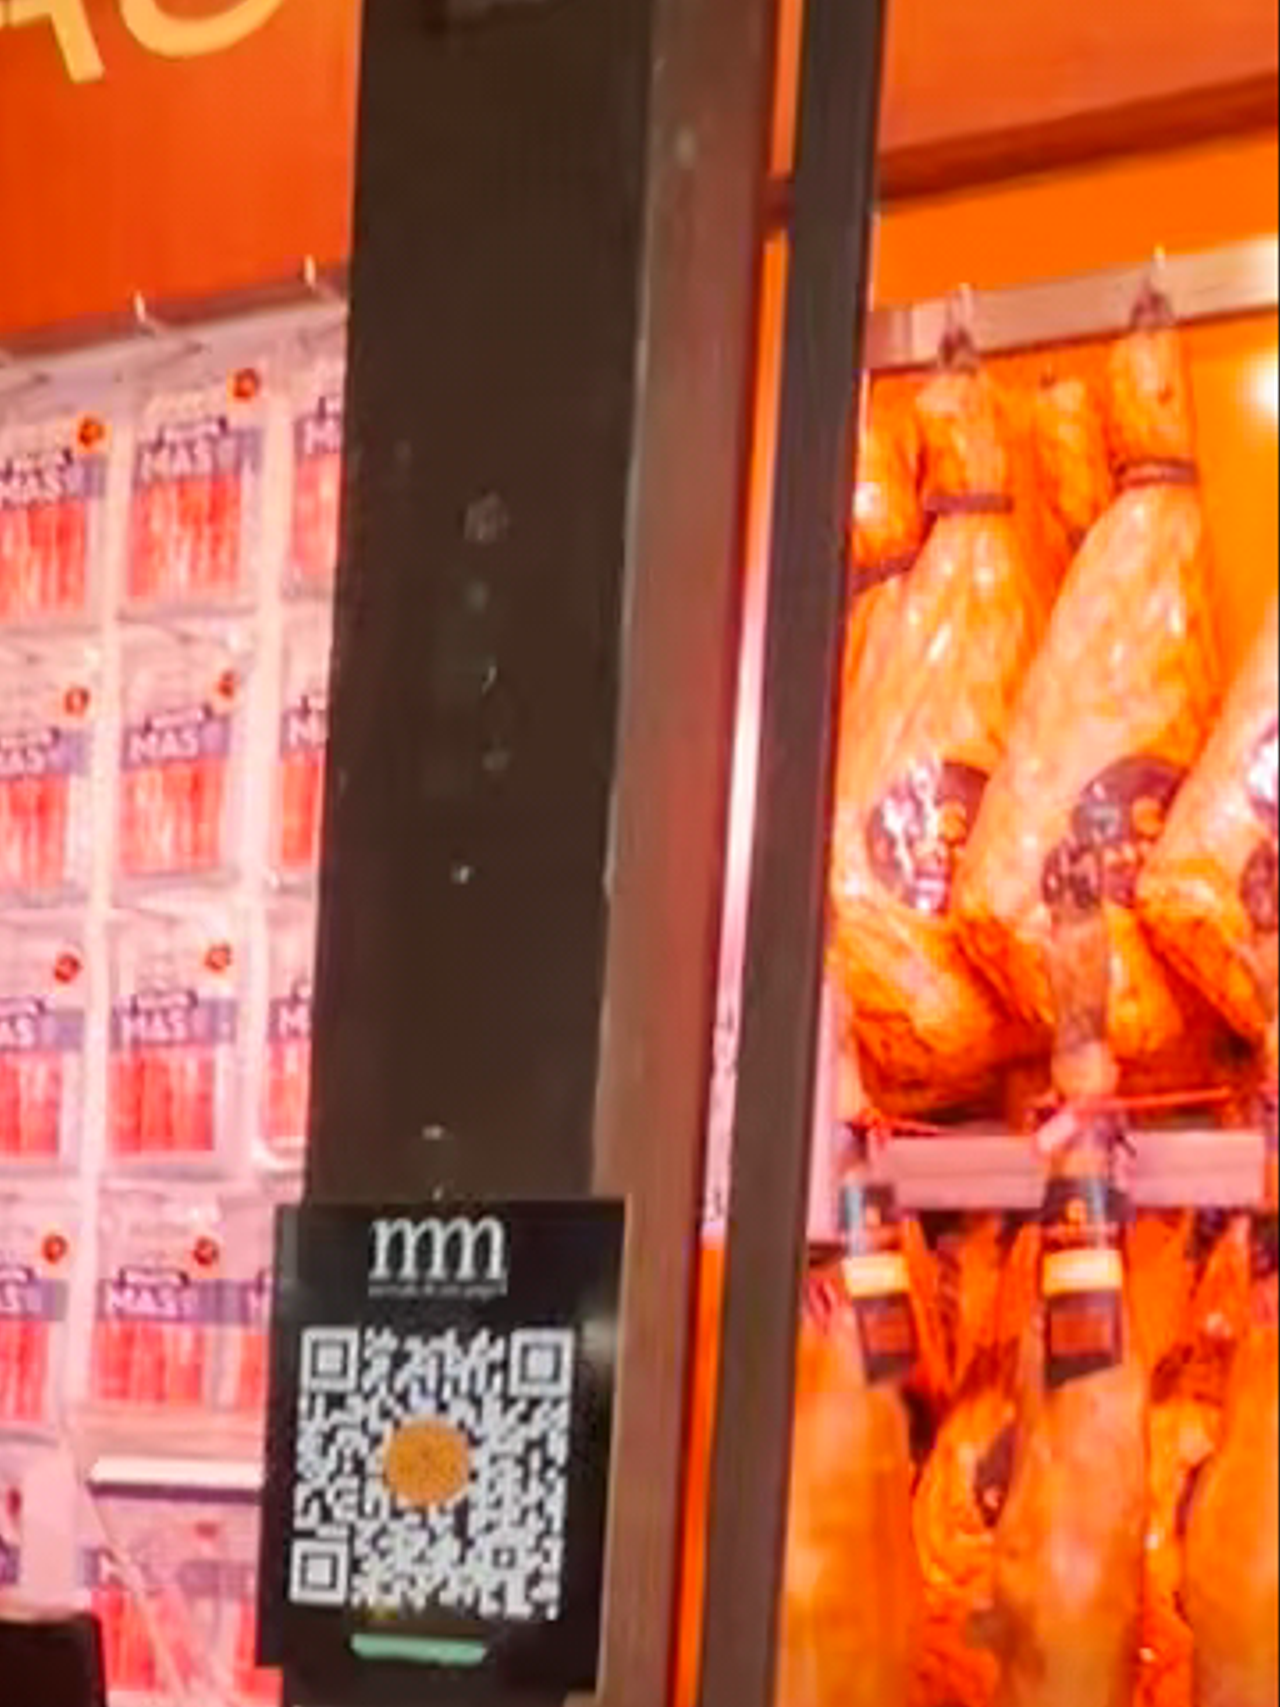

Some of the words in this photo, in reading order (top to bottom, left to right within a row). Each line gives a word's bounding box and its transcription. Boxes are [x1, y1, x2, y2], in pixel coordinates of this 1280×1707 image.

[129, 726, 198, 759] MAS
[120, 1007, 185, 1041] MAS
[108, 1287, 176, 1319] MAS
